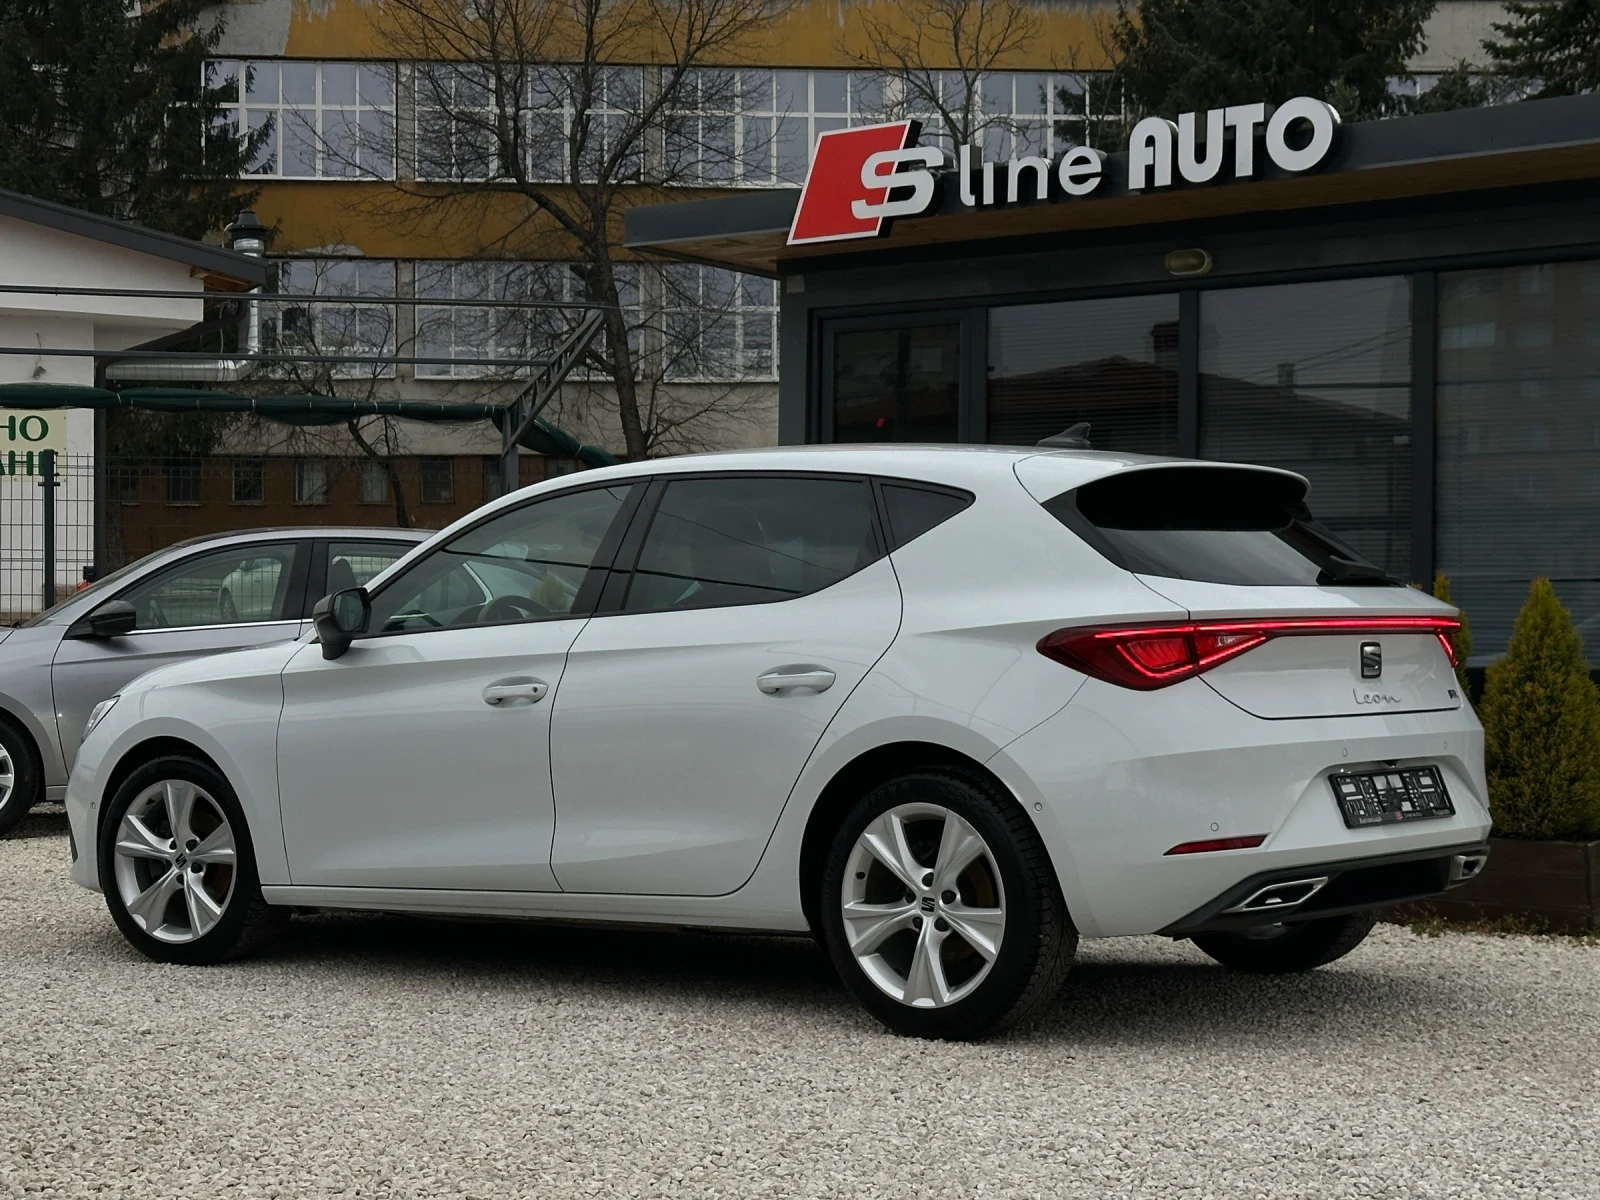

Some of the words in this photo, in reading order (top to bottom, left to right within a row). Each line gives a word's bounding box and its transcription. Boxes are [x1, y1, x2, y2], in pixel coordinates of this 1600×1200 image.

[850, 146, 944, 220] S
[959, 144, 1102, 207] line
[1128, 96, 1334, 190] AUTO
